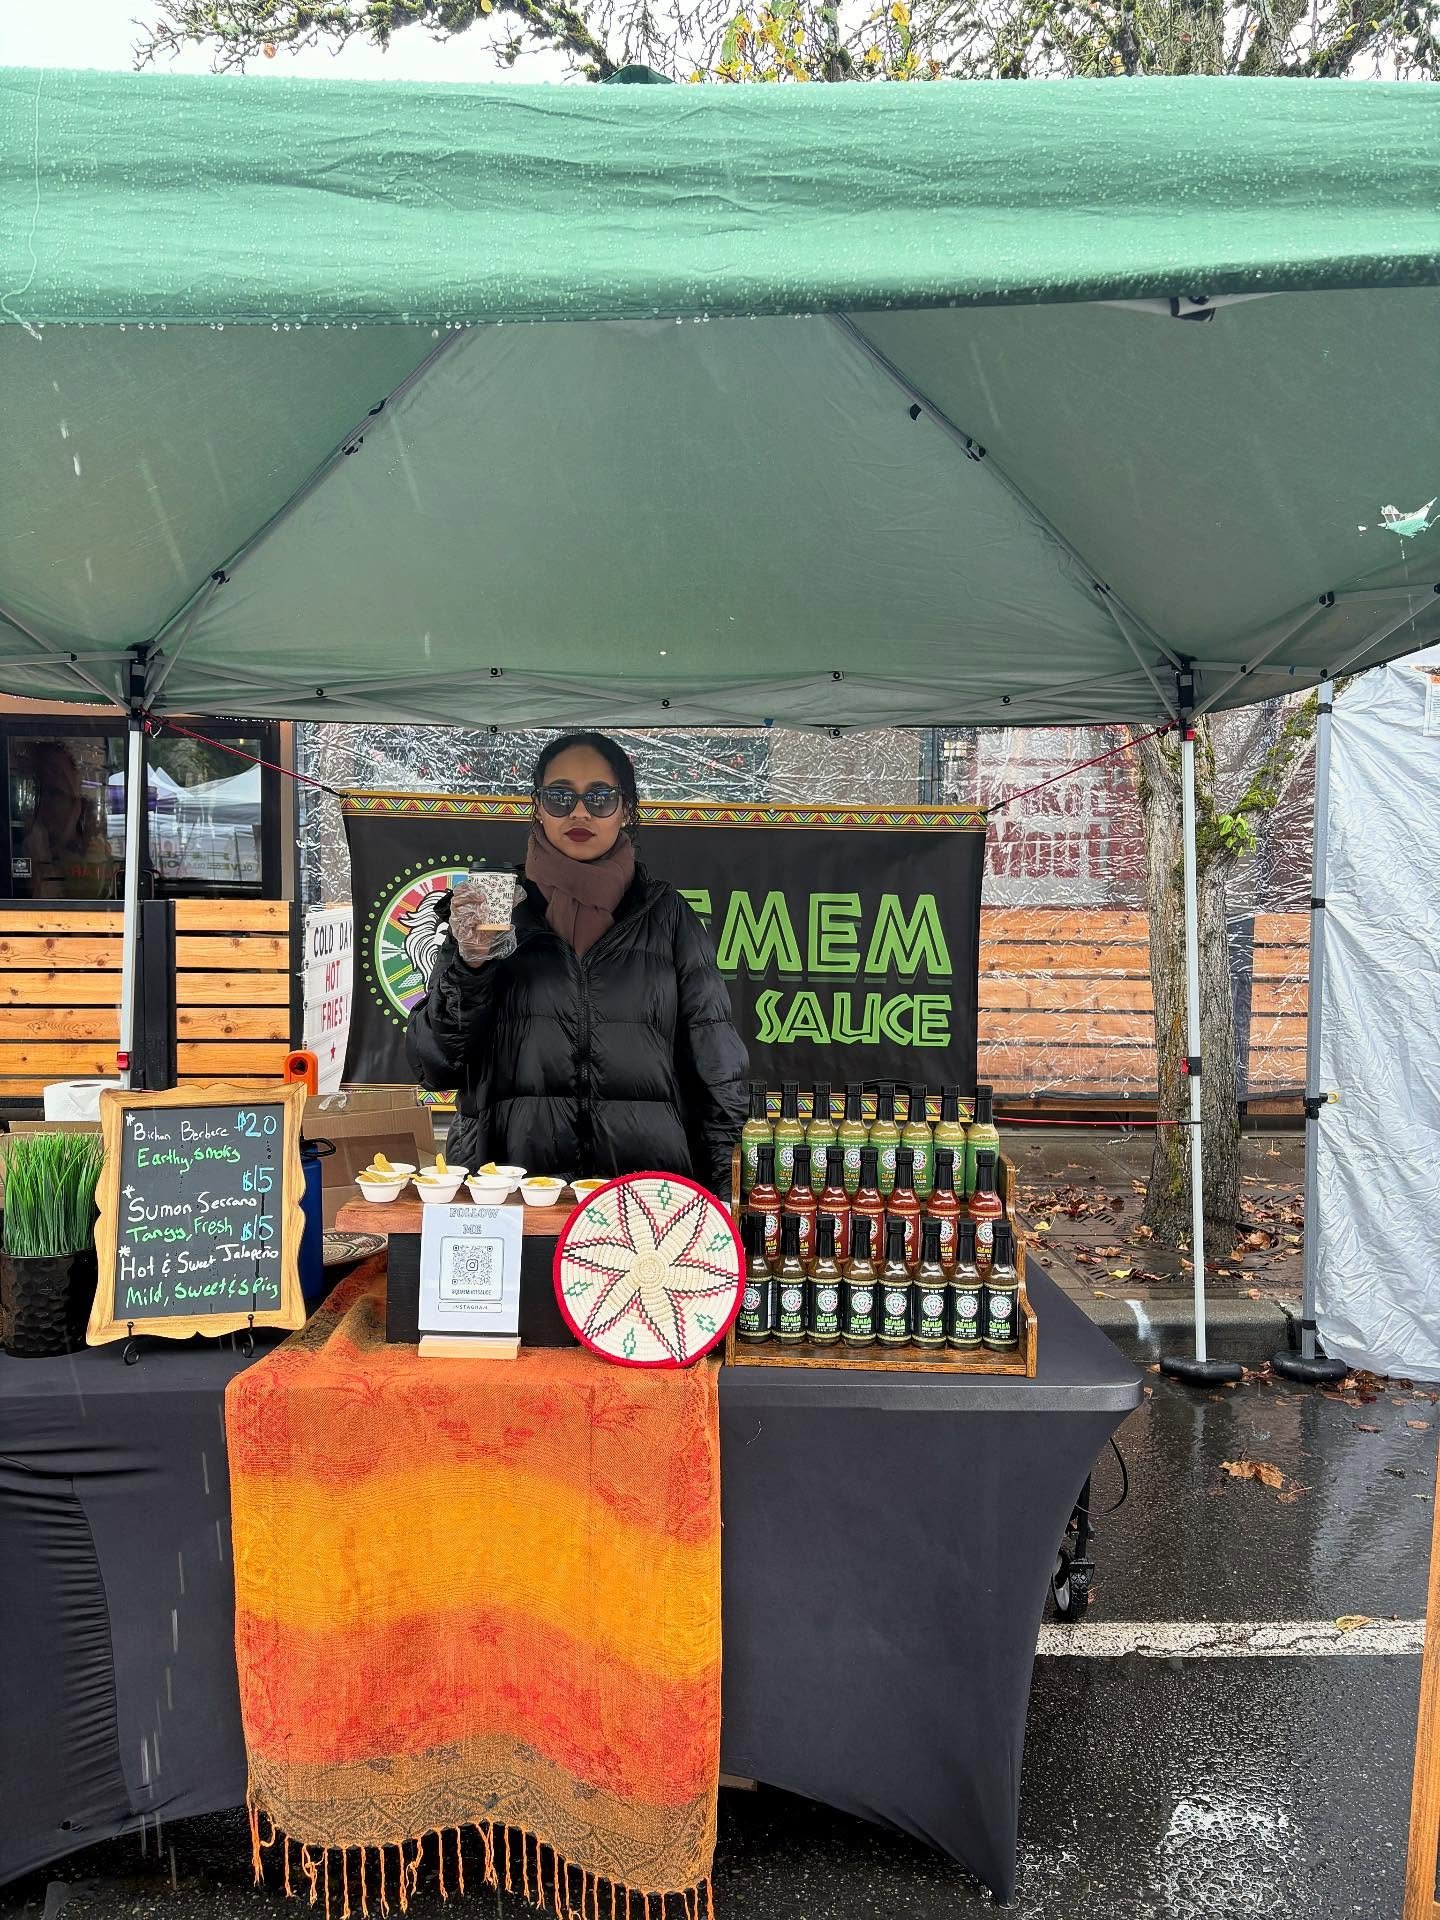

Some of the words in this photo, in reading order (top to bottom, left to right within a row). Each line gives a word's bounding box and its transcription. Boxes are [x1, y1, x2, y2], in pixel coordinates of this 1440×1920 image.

[314, 924, 334, 958] COLD
[325, 960, 341, 993] HOT
[321, 993, 349, 1032] FRIES!
[755, 989, 952, 1046] SAUCE
[234, 1110, 277, 1138] $20
[242, 1165, 275, 1193] $15
[198, 1192, 257, 1213] Serrano
[450, 1207, 501, 1219] FOLLOW
[194, 1216, 233, 1236] Fresh
[240, 1213, 274, 1242] $15
[120, 1256, 154, 1281] Hot
[177, 1251, 216, 1274] Sweet
[125, 1281, 169, 1308] Mild,
